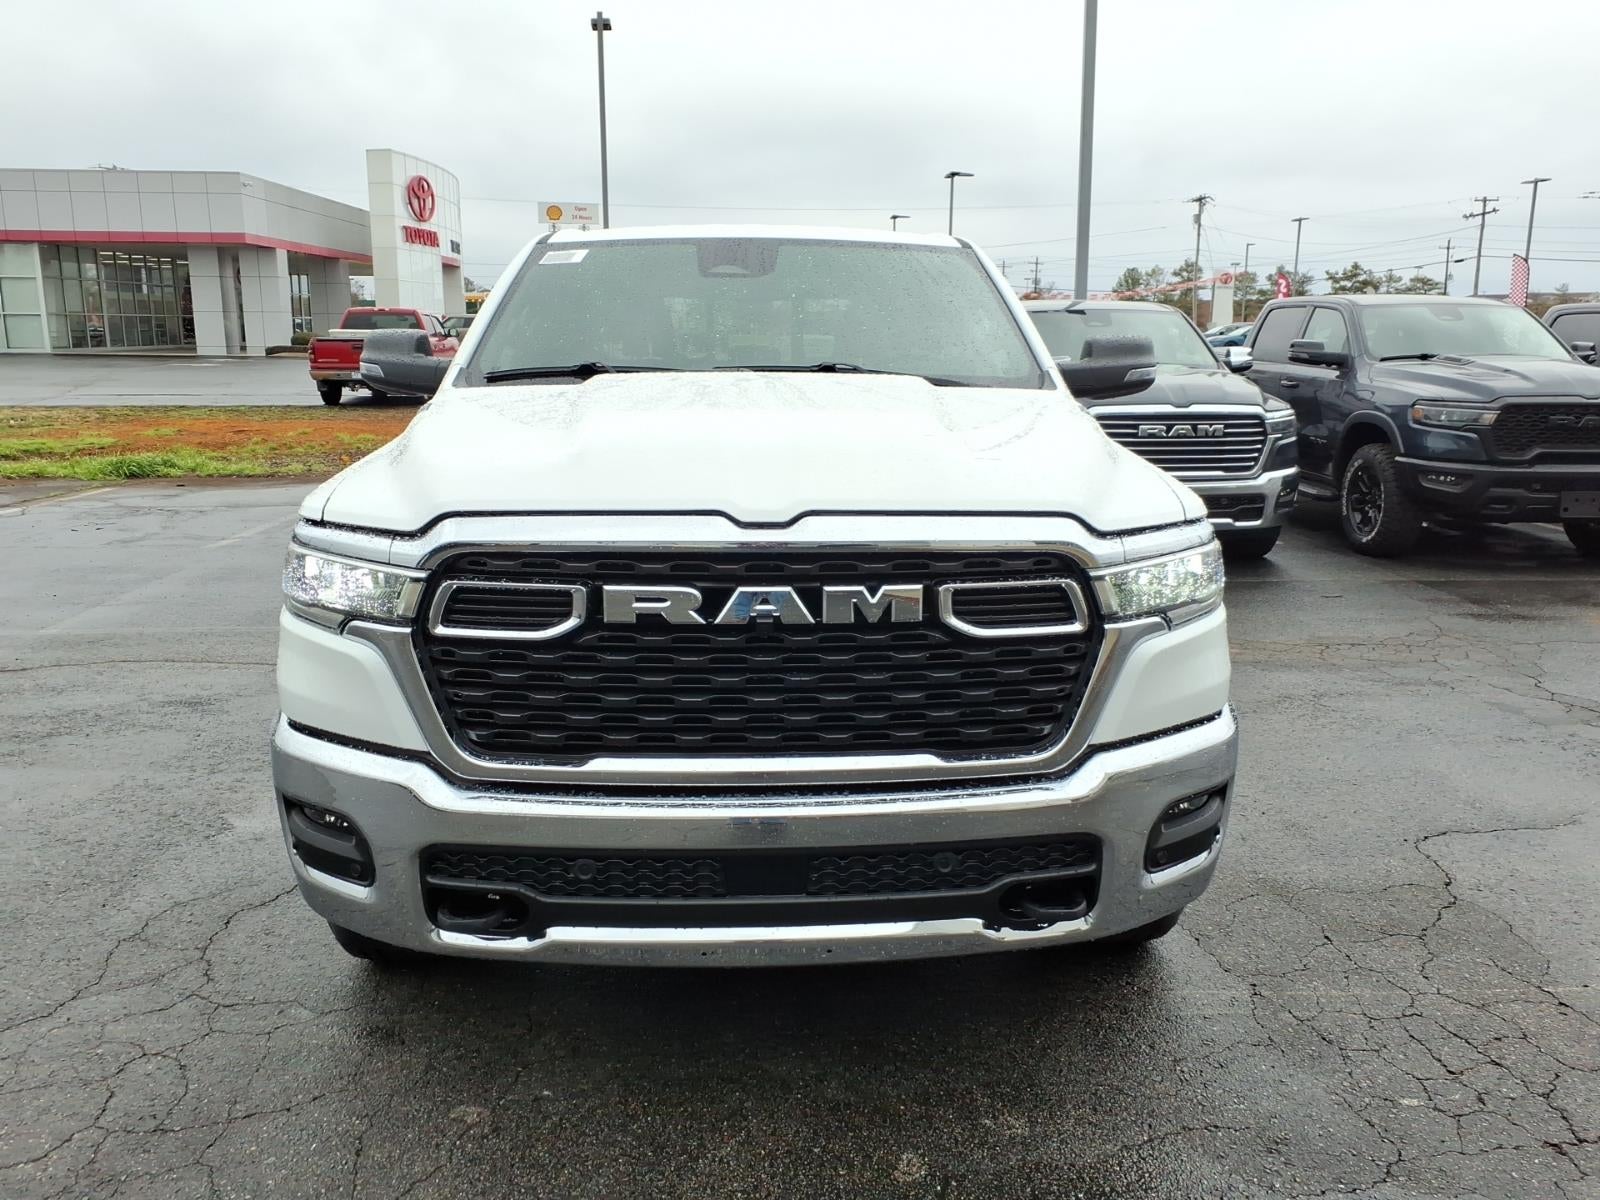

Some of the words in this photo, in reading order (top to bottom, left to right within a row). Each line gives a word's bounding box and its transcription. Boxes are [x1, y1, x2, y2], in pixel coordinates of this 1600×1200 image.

[402, 225, 440, 248] TOYOTA
[1138, 424, 1224, 437] RAM
[602, 585, 924, 625] RAM
